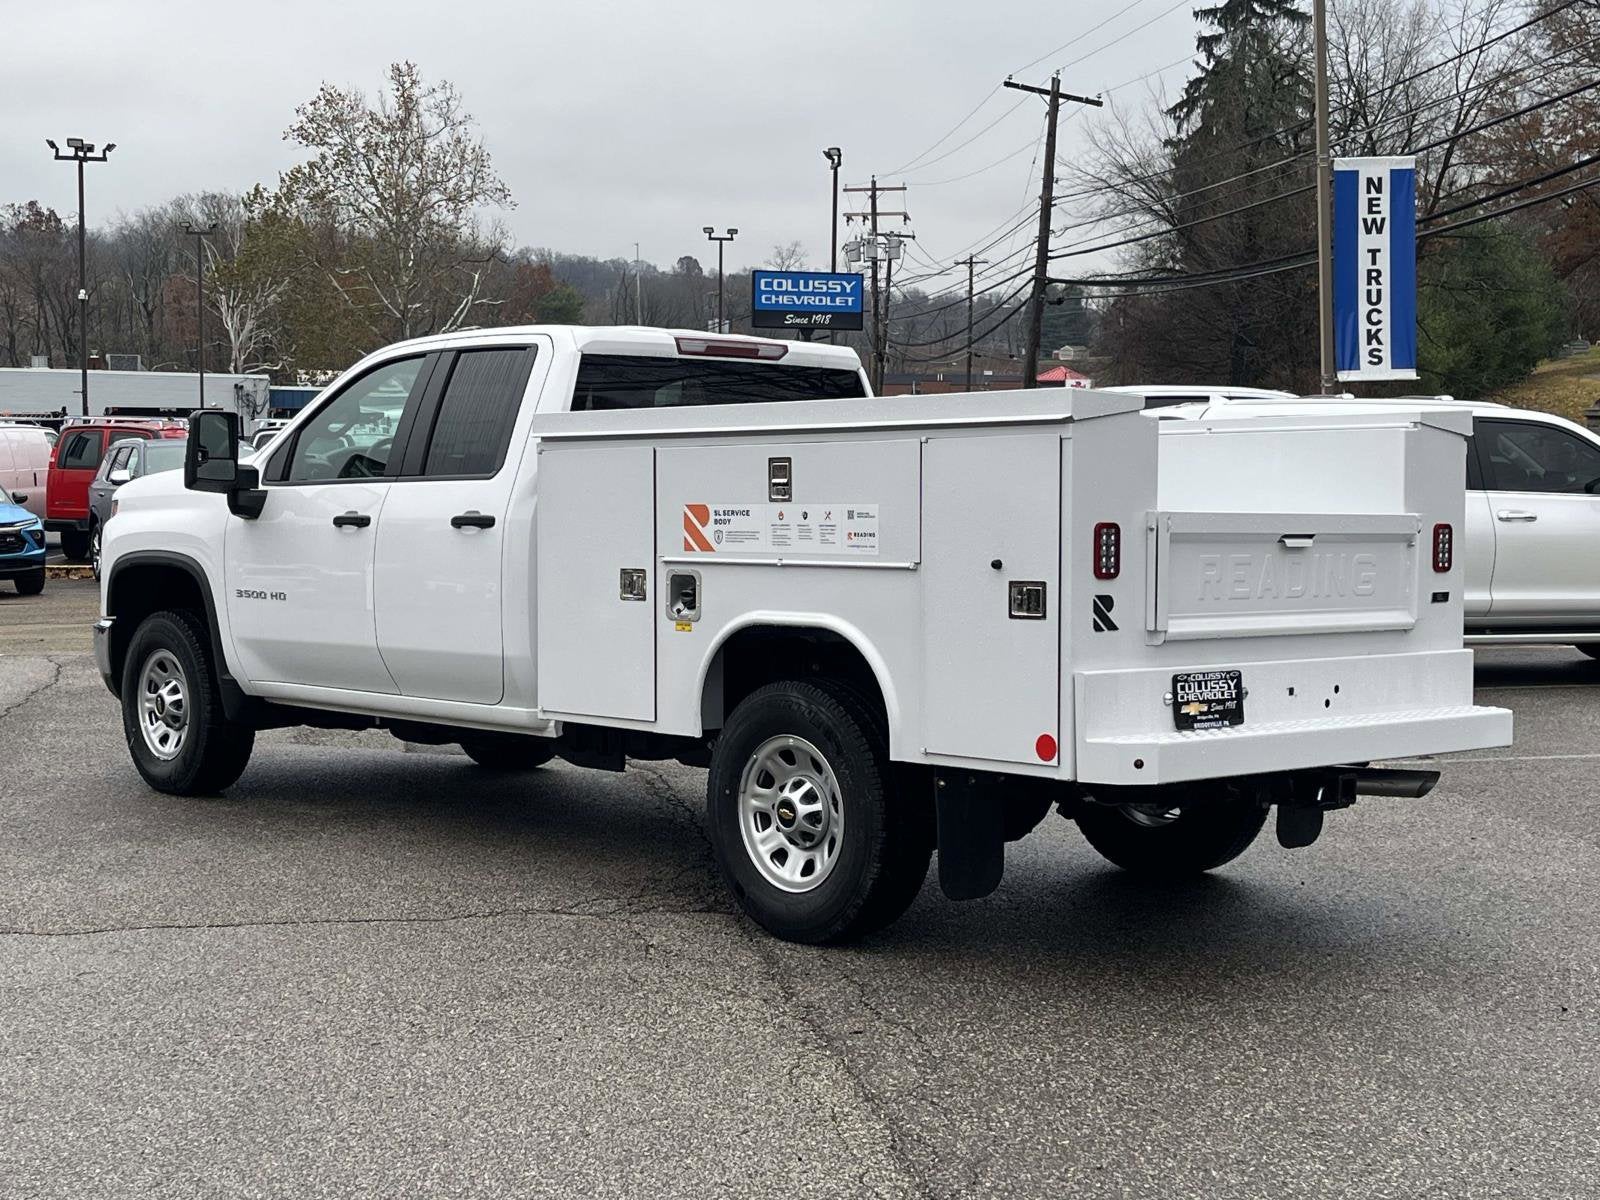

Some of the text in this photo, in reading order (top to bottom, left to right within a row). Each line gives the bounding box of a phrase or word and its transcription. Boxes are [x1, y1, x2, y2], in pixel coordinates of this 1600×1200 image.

[1362, 176, 1386, 235] NEW
[760, 278, 856, 293] COLUSSY
[761, 294, 856, 306] CHEVROLET
[1365, 248, 1383, 366] TRUCKS
[784, 314, 832, 325] Since 1918
[722, 509, 750, 517] SERVICE
[714, 518, 731, 526] BODY
[1198, 554, 1377, 601] READING
[235, 589, 287, 601] 3500 HD
[1177, 679, 1237, 693] COLUSSY
[1177, 690, 1237, 702] CHEVROLET
